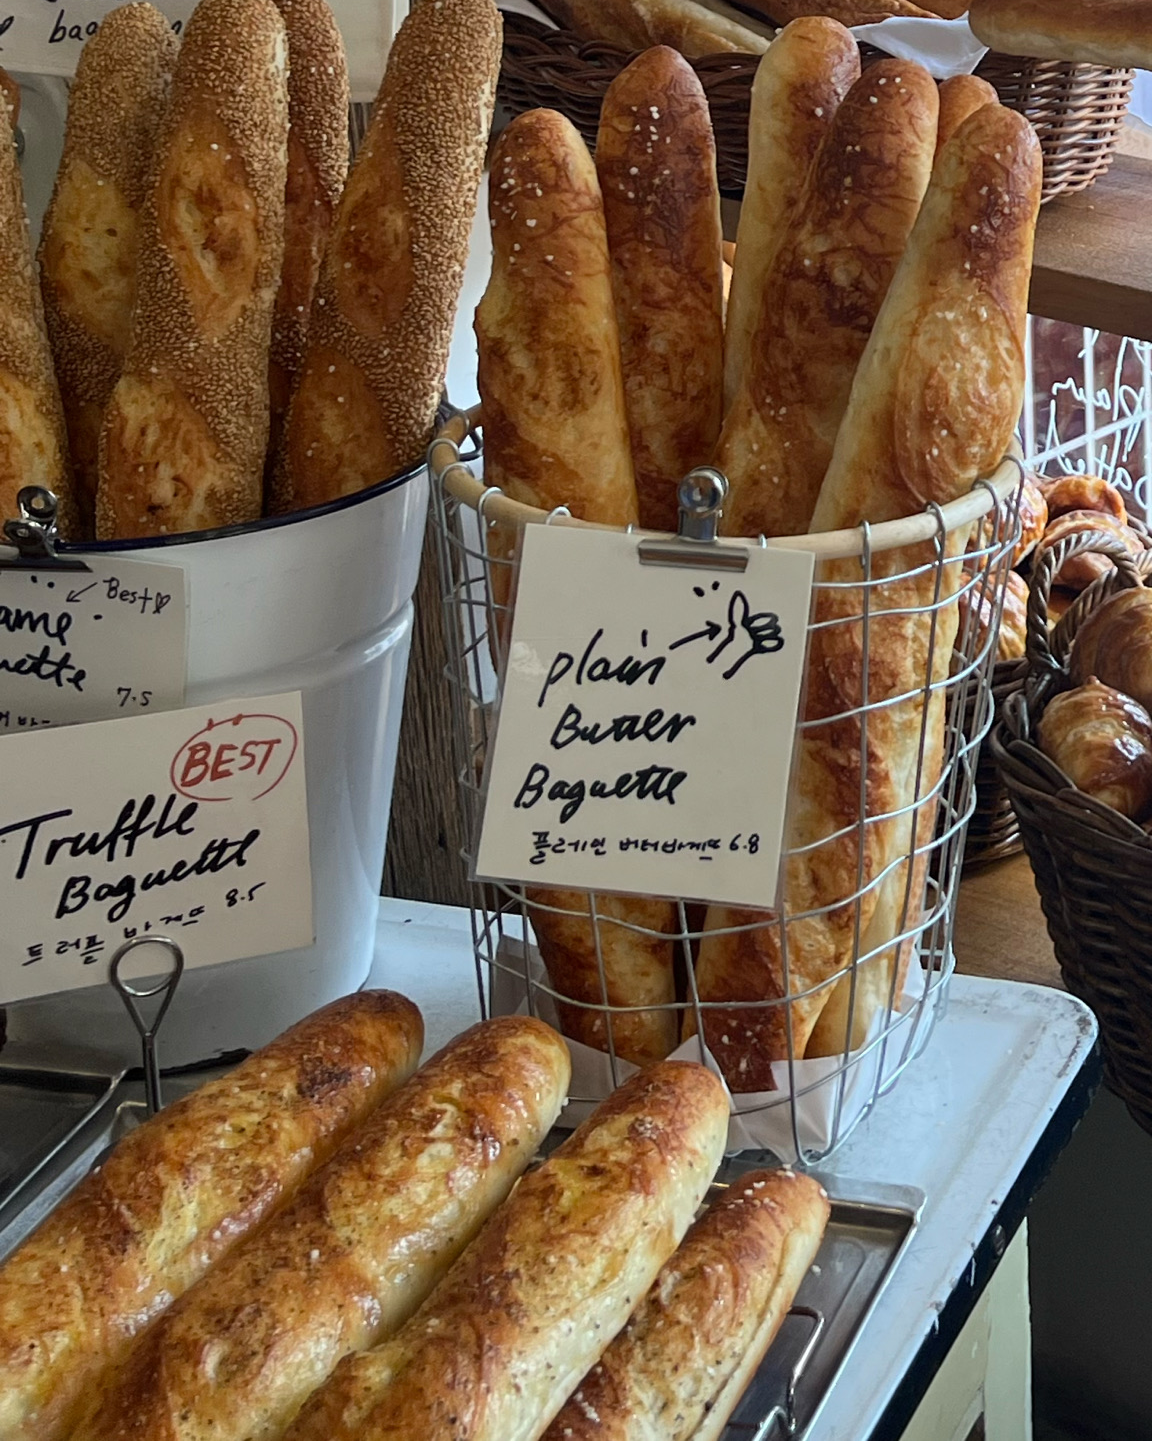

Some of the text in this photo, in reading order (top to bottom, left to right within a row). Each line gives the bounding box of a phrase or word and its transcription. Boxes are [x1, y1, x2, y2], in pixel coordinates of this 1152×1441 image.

[103, 577, 153, 614] Best
[117, 687, 152, 707] 7.5
[550, 703, 696, 749] Butter
[180, 738, 282, 787] BEST
[513, 763, 688, 824] Baguette
[0, 793, 199, 879] Truffle
[729, 833, 760, 855] 6.8
[55, 829, 260, 923] Baguette
[225, 882, 266, 907] 8.5
